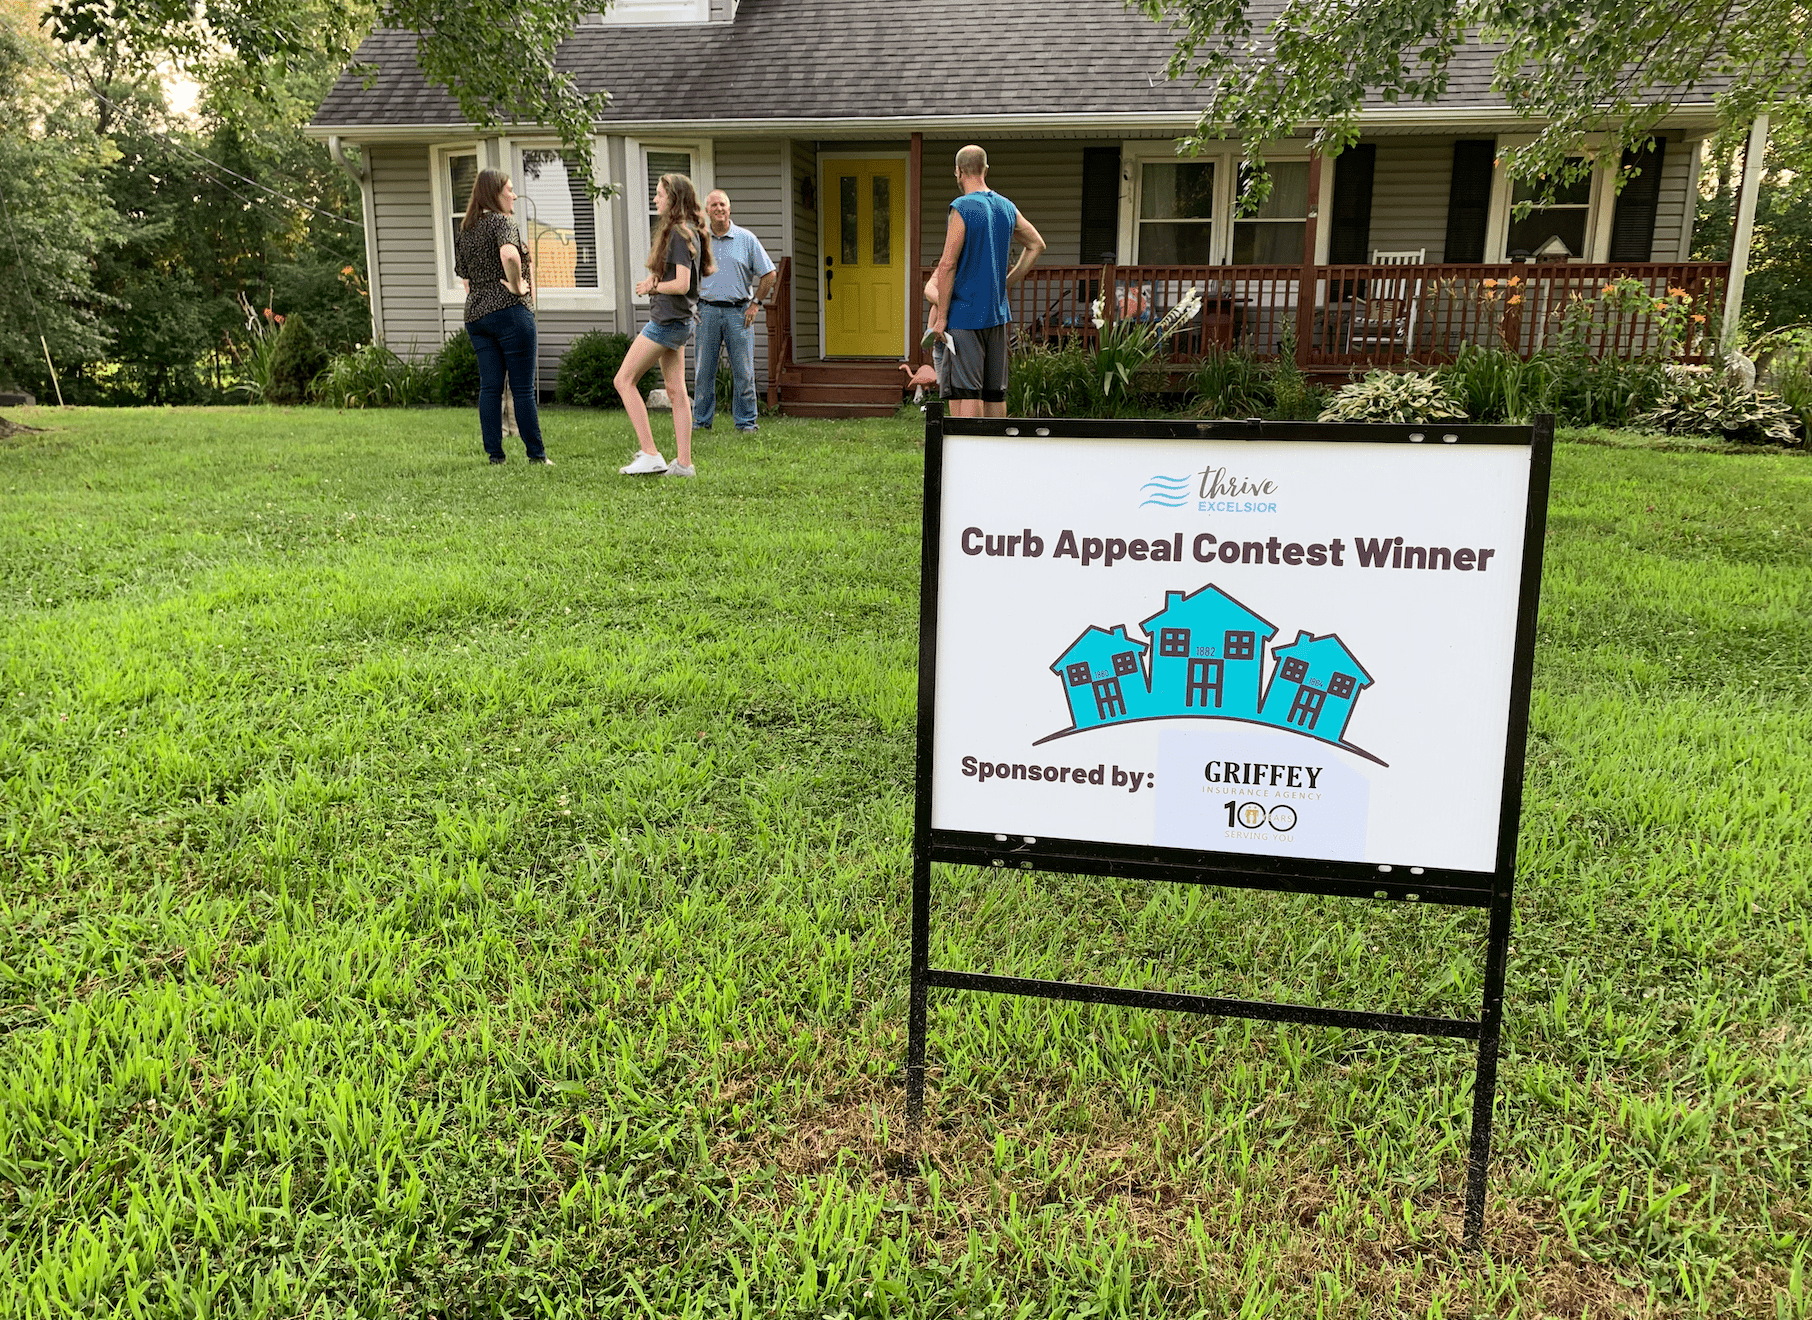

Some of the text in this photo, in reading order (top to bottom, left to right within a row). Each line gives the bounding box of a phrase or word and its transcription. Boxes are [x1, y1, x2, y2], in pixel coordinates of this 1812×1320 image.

[1198, 466, 1278, 499] thrive
[1198, 501, 1277, 513] EXCELSIOR
[961, 527, 1495, 571] Curb Appeal Contest Winner
[1196, 646, 1216, 657] 1882
[961, 756, 1154, 793] Sponsored by:
[1204, 760, 1323, 789] GRIFFEY
[1202, 785, 1322, 801] INSURANCE AGENCY
[1224, 800, 1297, 832] 100
[1224, 830, 1294, 843] SERVING YOU
